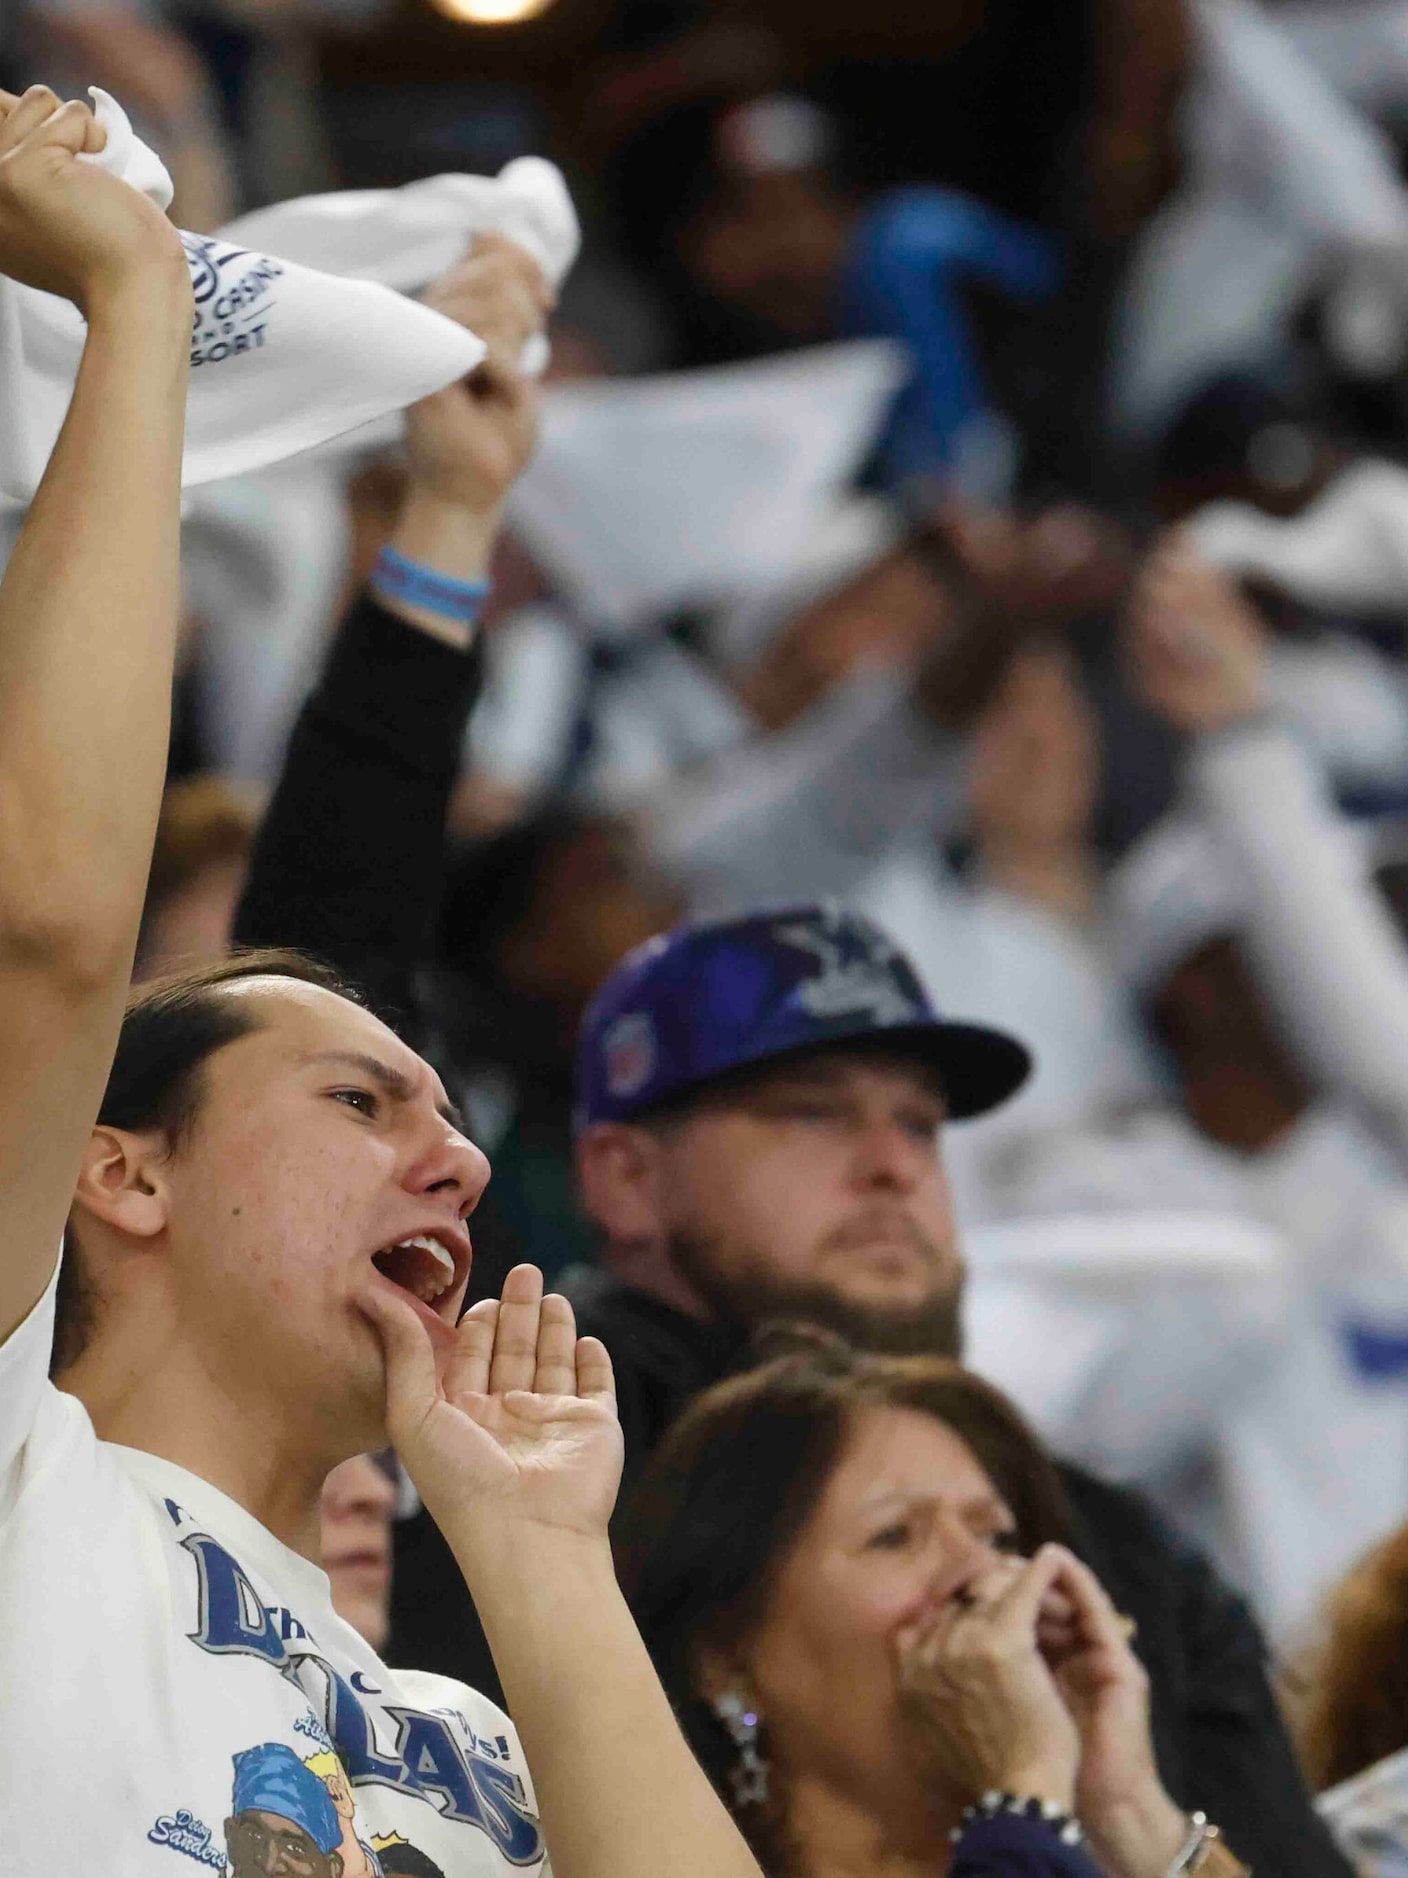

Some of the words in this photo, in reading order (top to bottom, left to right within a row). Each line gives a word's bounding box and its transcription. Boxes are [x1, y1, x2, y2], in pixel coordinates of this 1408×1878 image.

[189, 323, 268, 368] SORT
[177, 1532, 545, 1868] DLAS
[147, 1815, 228, 1871] Sanders
